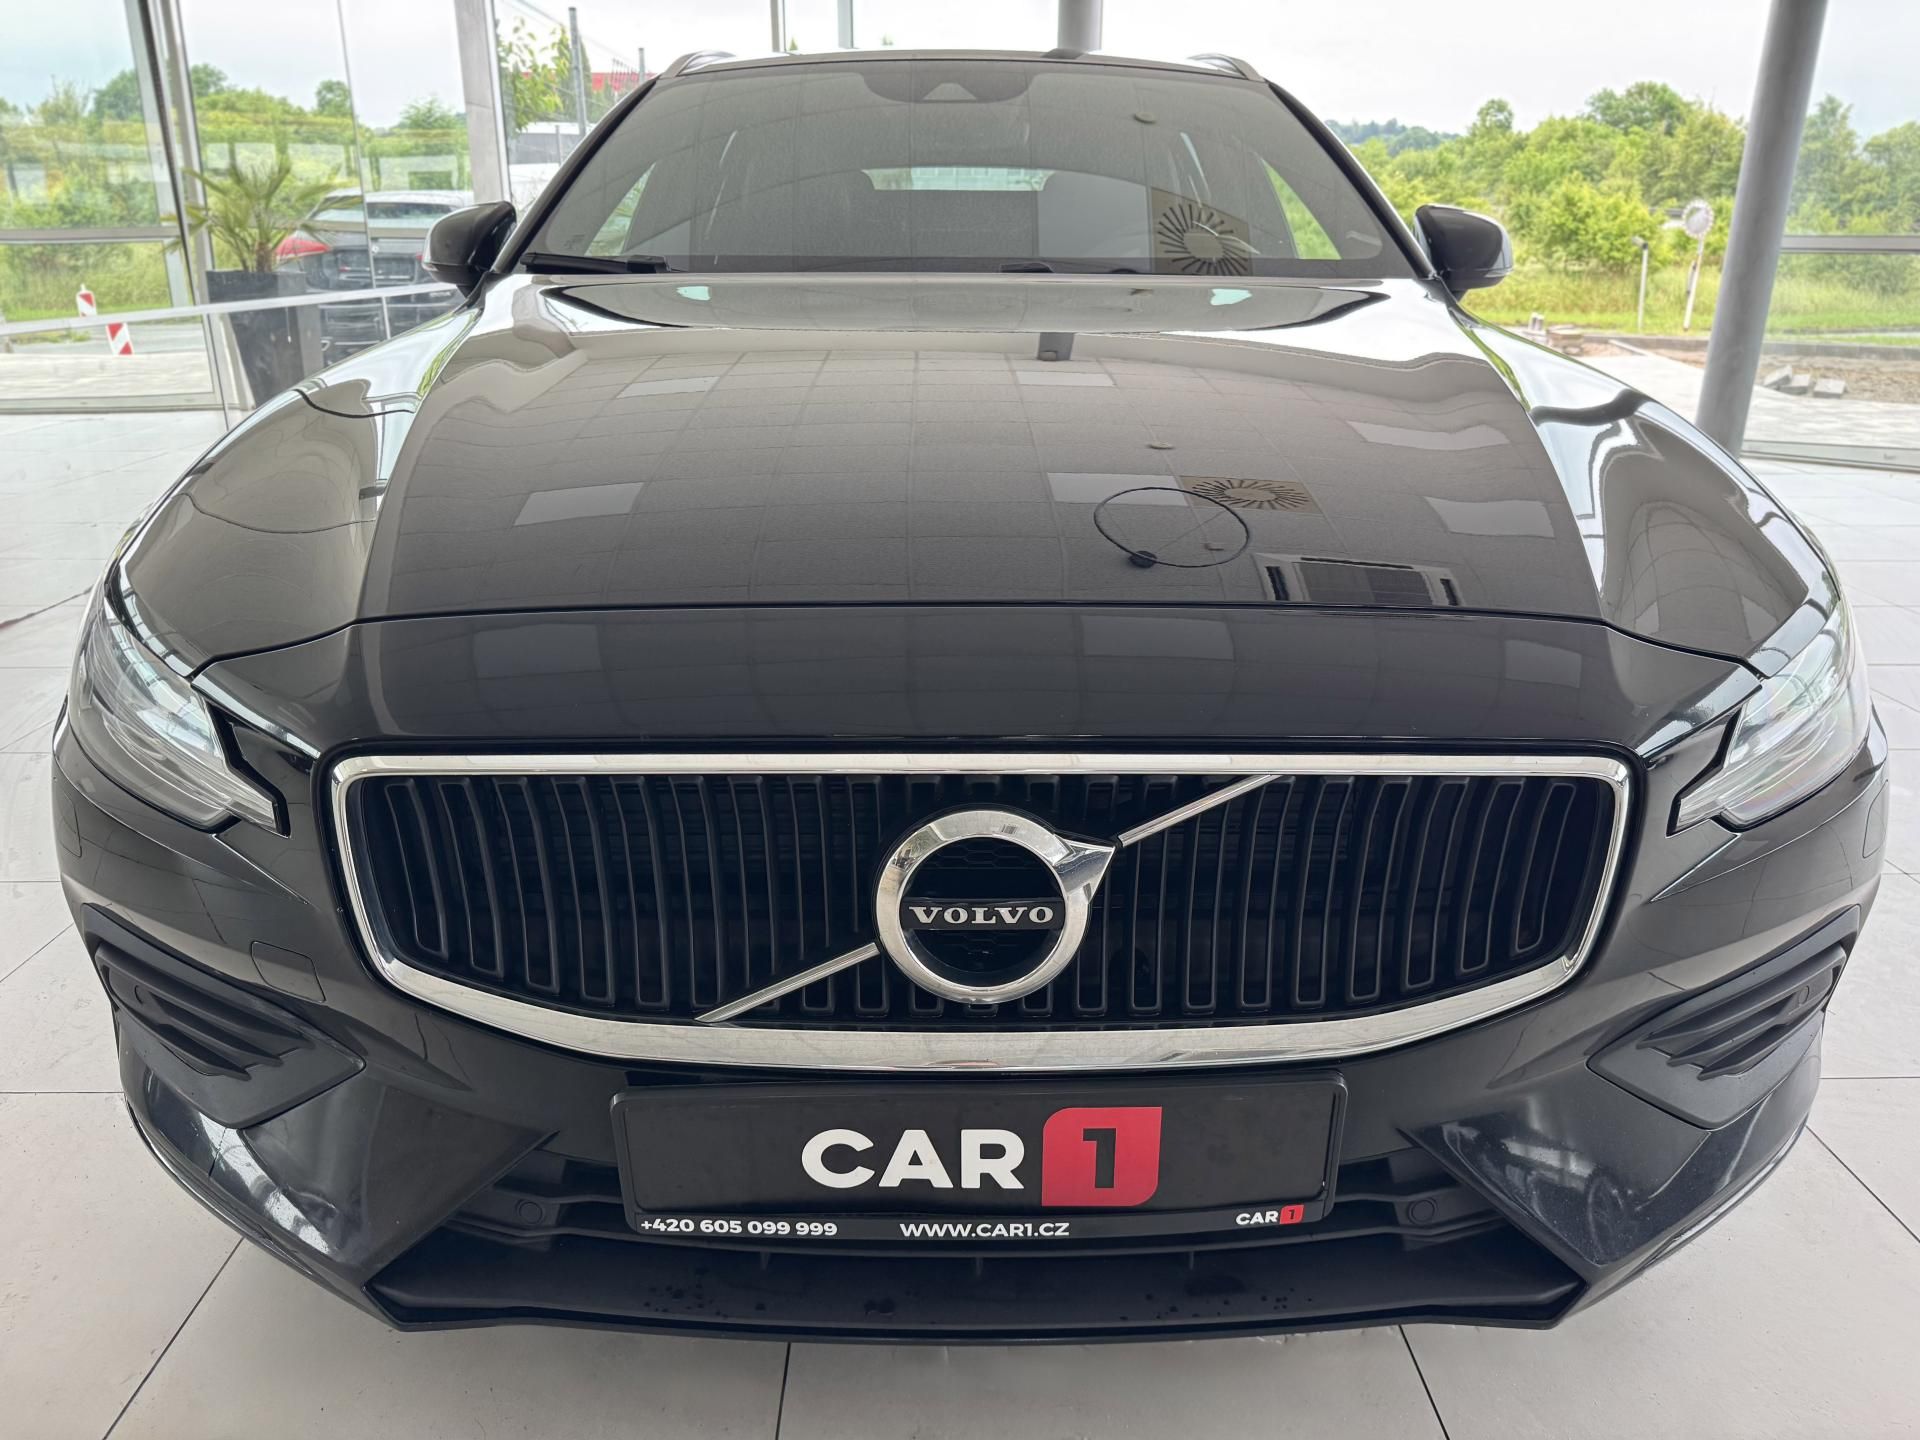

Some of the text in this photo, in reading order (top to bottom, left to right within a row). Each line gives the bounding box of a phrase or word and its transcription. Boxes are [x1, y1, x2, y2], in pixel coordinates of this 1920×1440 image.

[908, 906, 1054, 924] VOLVO
[801, 1127, 1117, 1189] CAR 1
[1235, 1210, 1279, 1225] CAR
[641, 1218, 838, 1236] +420 605 099 999
[900, 1222, 1070, 1237] WWW.CAR1.CZ
